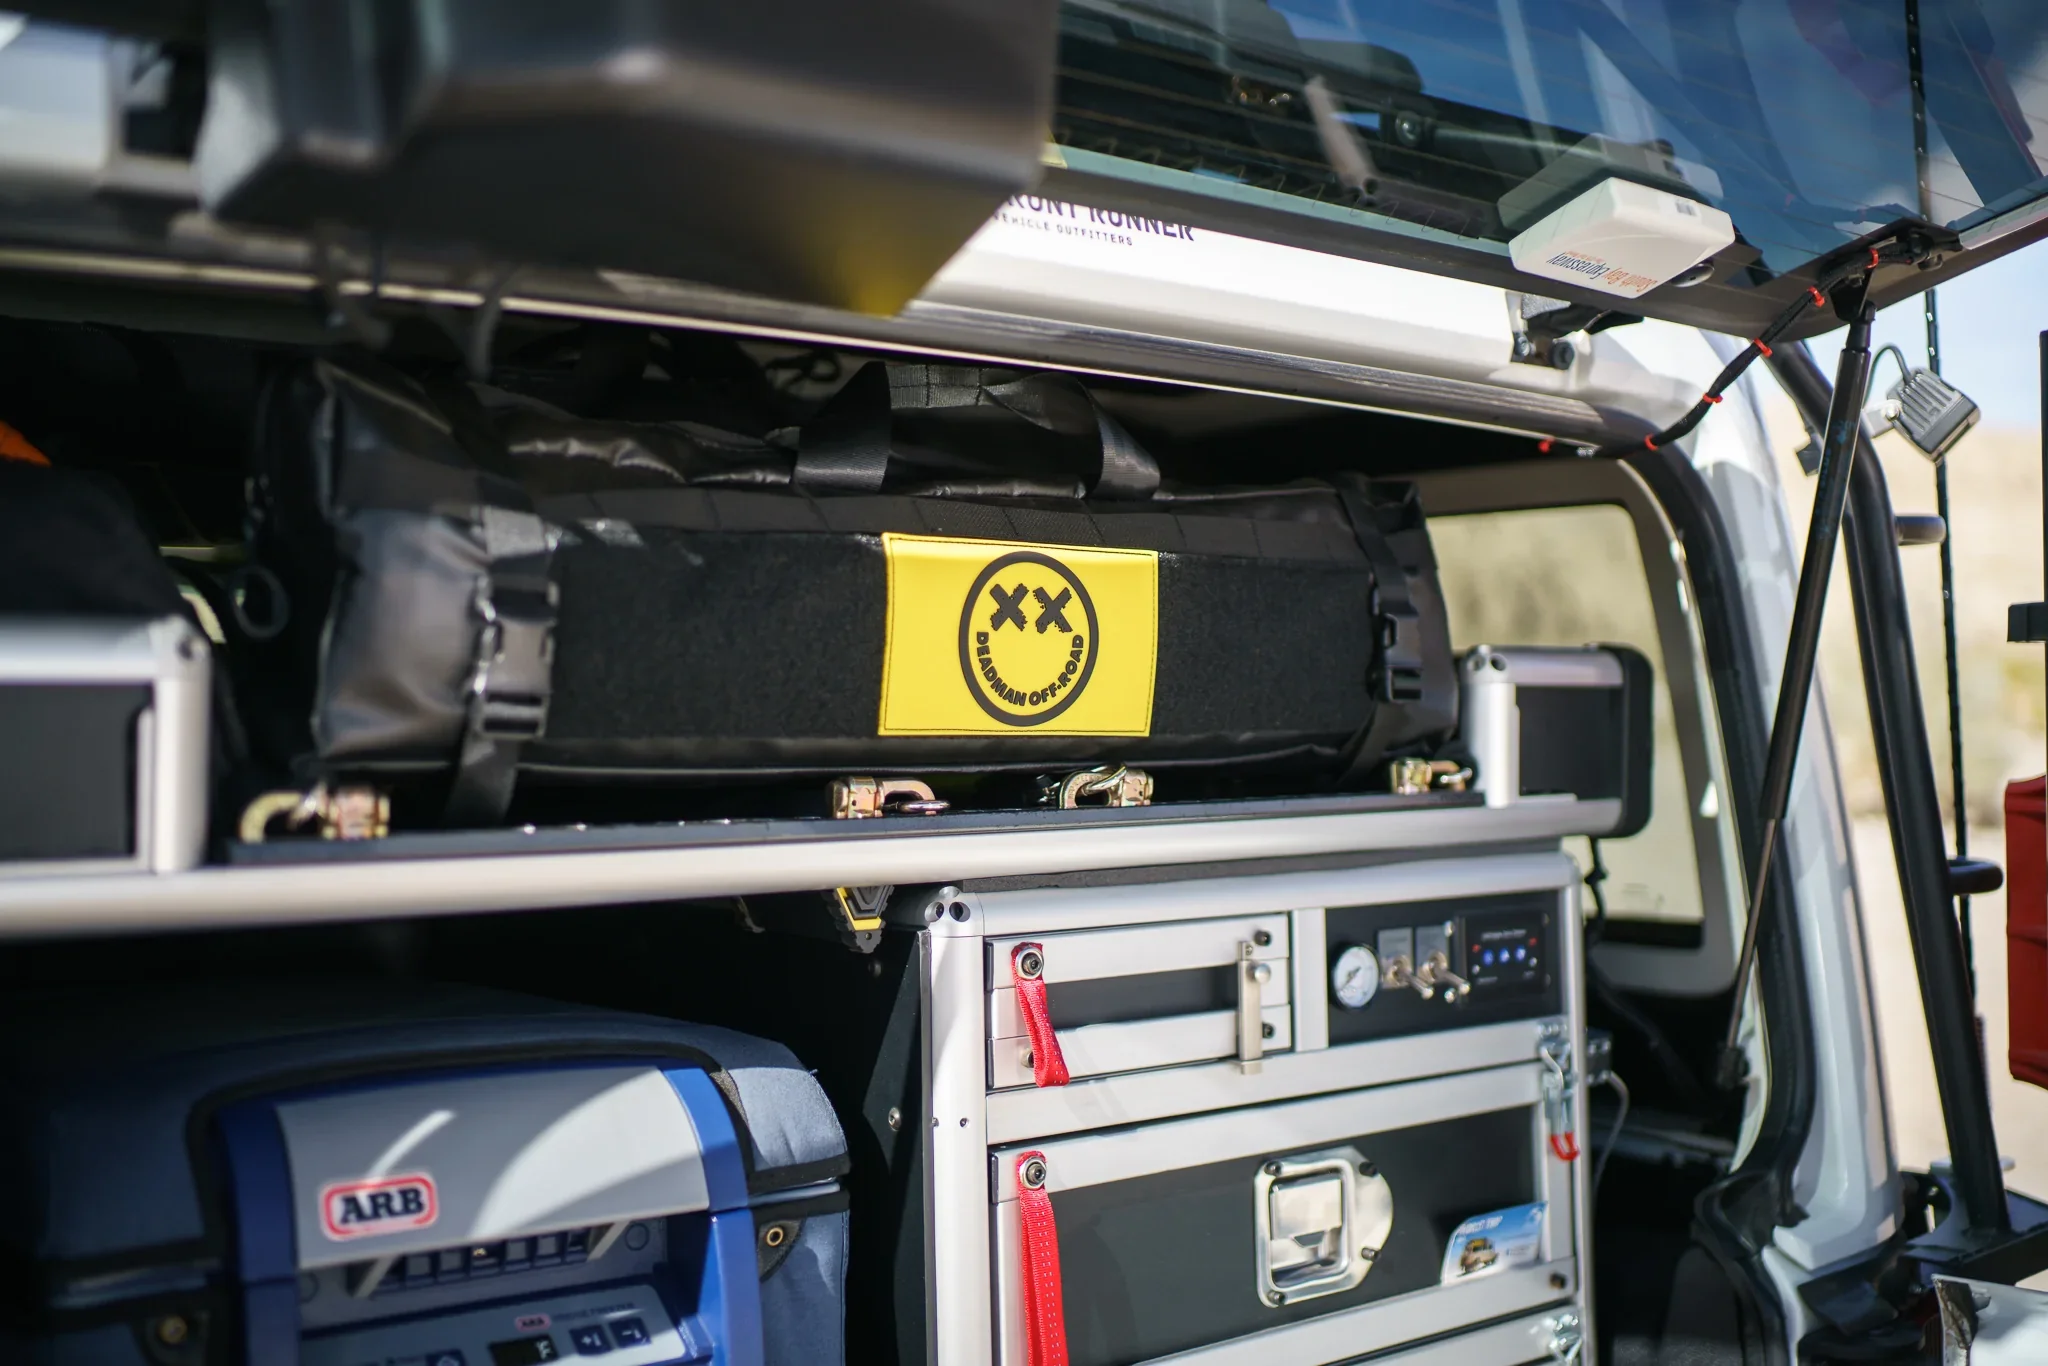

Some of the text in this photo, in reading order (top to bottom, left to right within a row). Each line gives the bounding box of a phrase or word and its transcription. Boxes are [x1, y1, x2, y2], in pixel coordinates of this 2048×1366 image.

[1008, 194, 1077, 219] RONT
[1056, 223, 1134, 246] OUTFITTERS
[1546, 252, 1610, 280] Expressway
[976, 631, 1027, 706] DEADMAN
[340, 1187, 425, 1225] ARB
